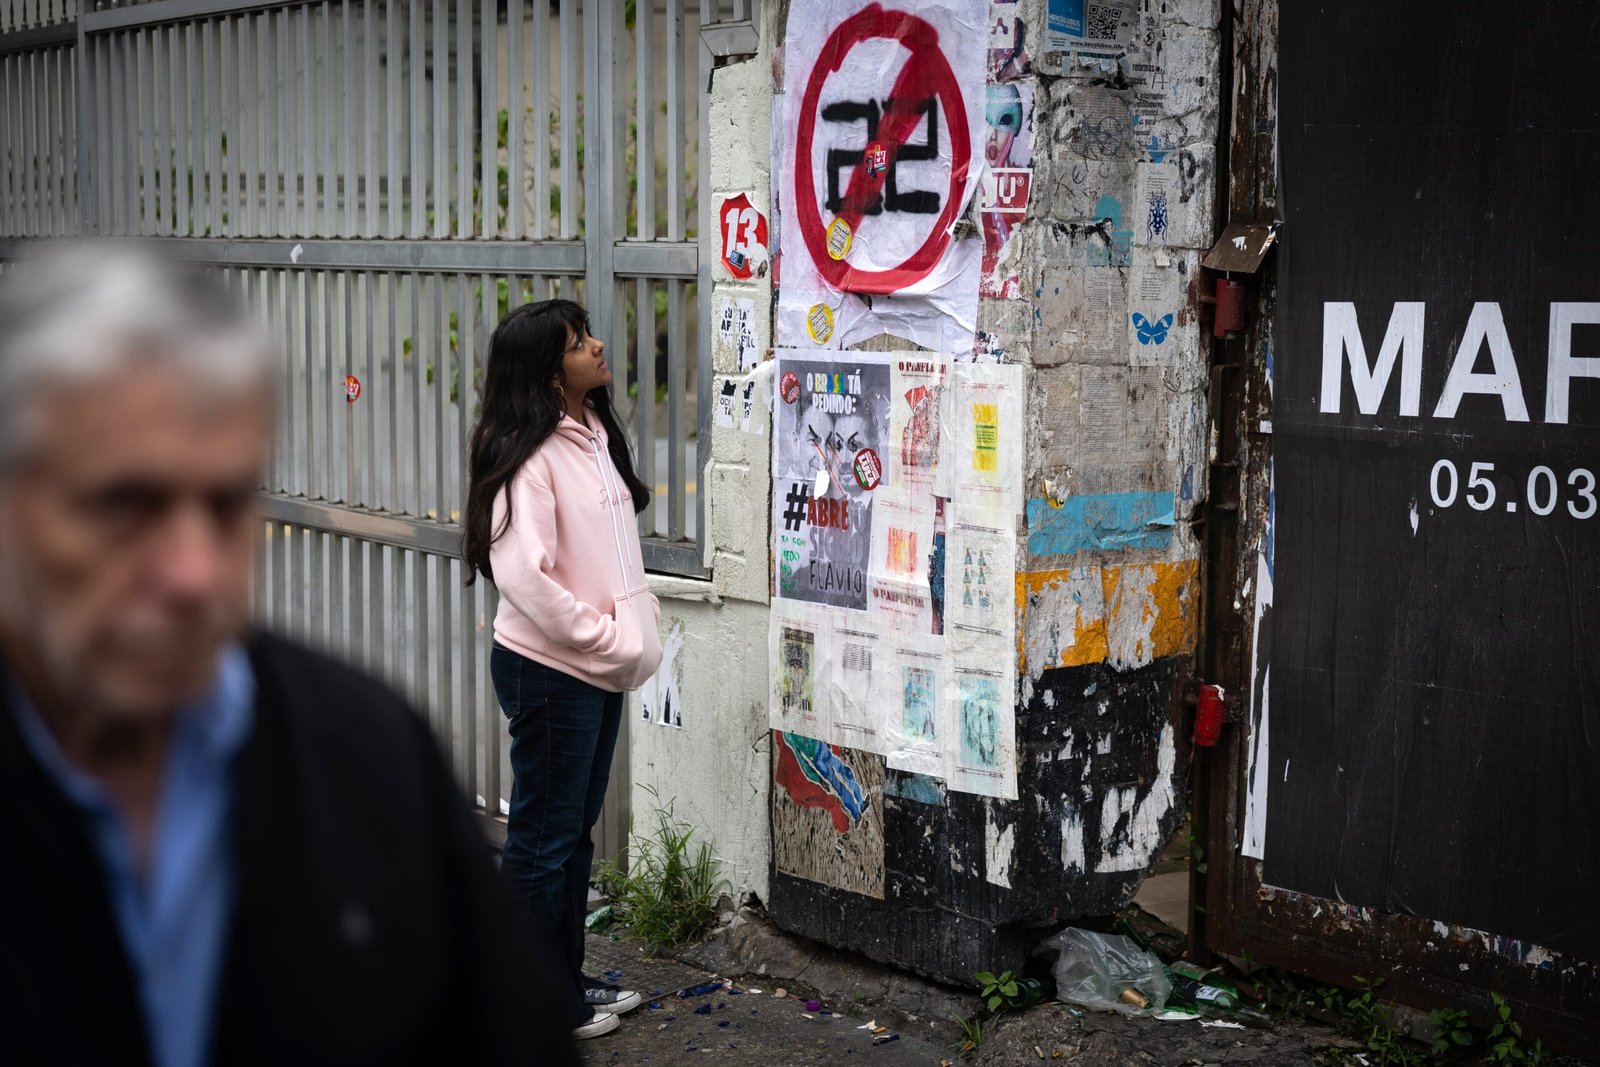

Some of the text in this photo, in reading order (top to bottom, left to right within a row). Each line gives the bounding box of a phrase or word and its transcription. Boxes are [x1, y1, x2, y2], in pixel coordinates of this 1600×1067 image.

[822, 97, 941, 215] 22
[725, 207, 760, 259] 13
[807, 372, 814, 392] O
[815, 372, 845, 394] BRASIL
[847, 368, 861, 395] TÁ
[898, 361, 905, 372] O
[812, 393, 857, 415] PEDINDO:
[783, 483, 849, 532] #ABRE
[809, 560, 862, 594] FLAVIO
